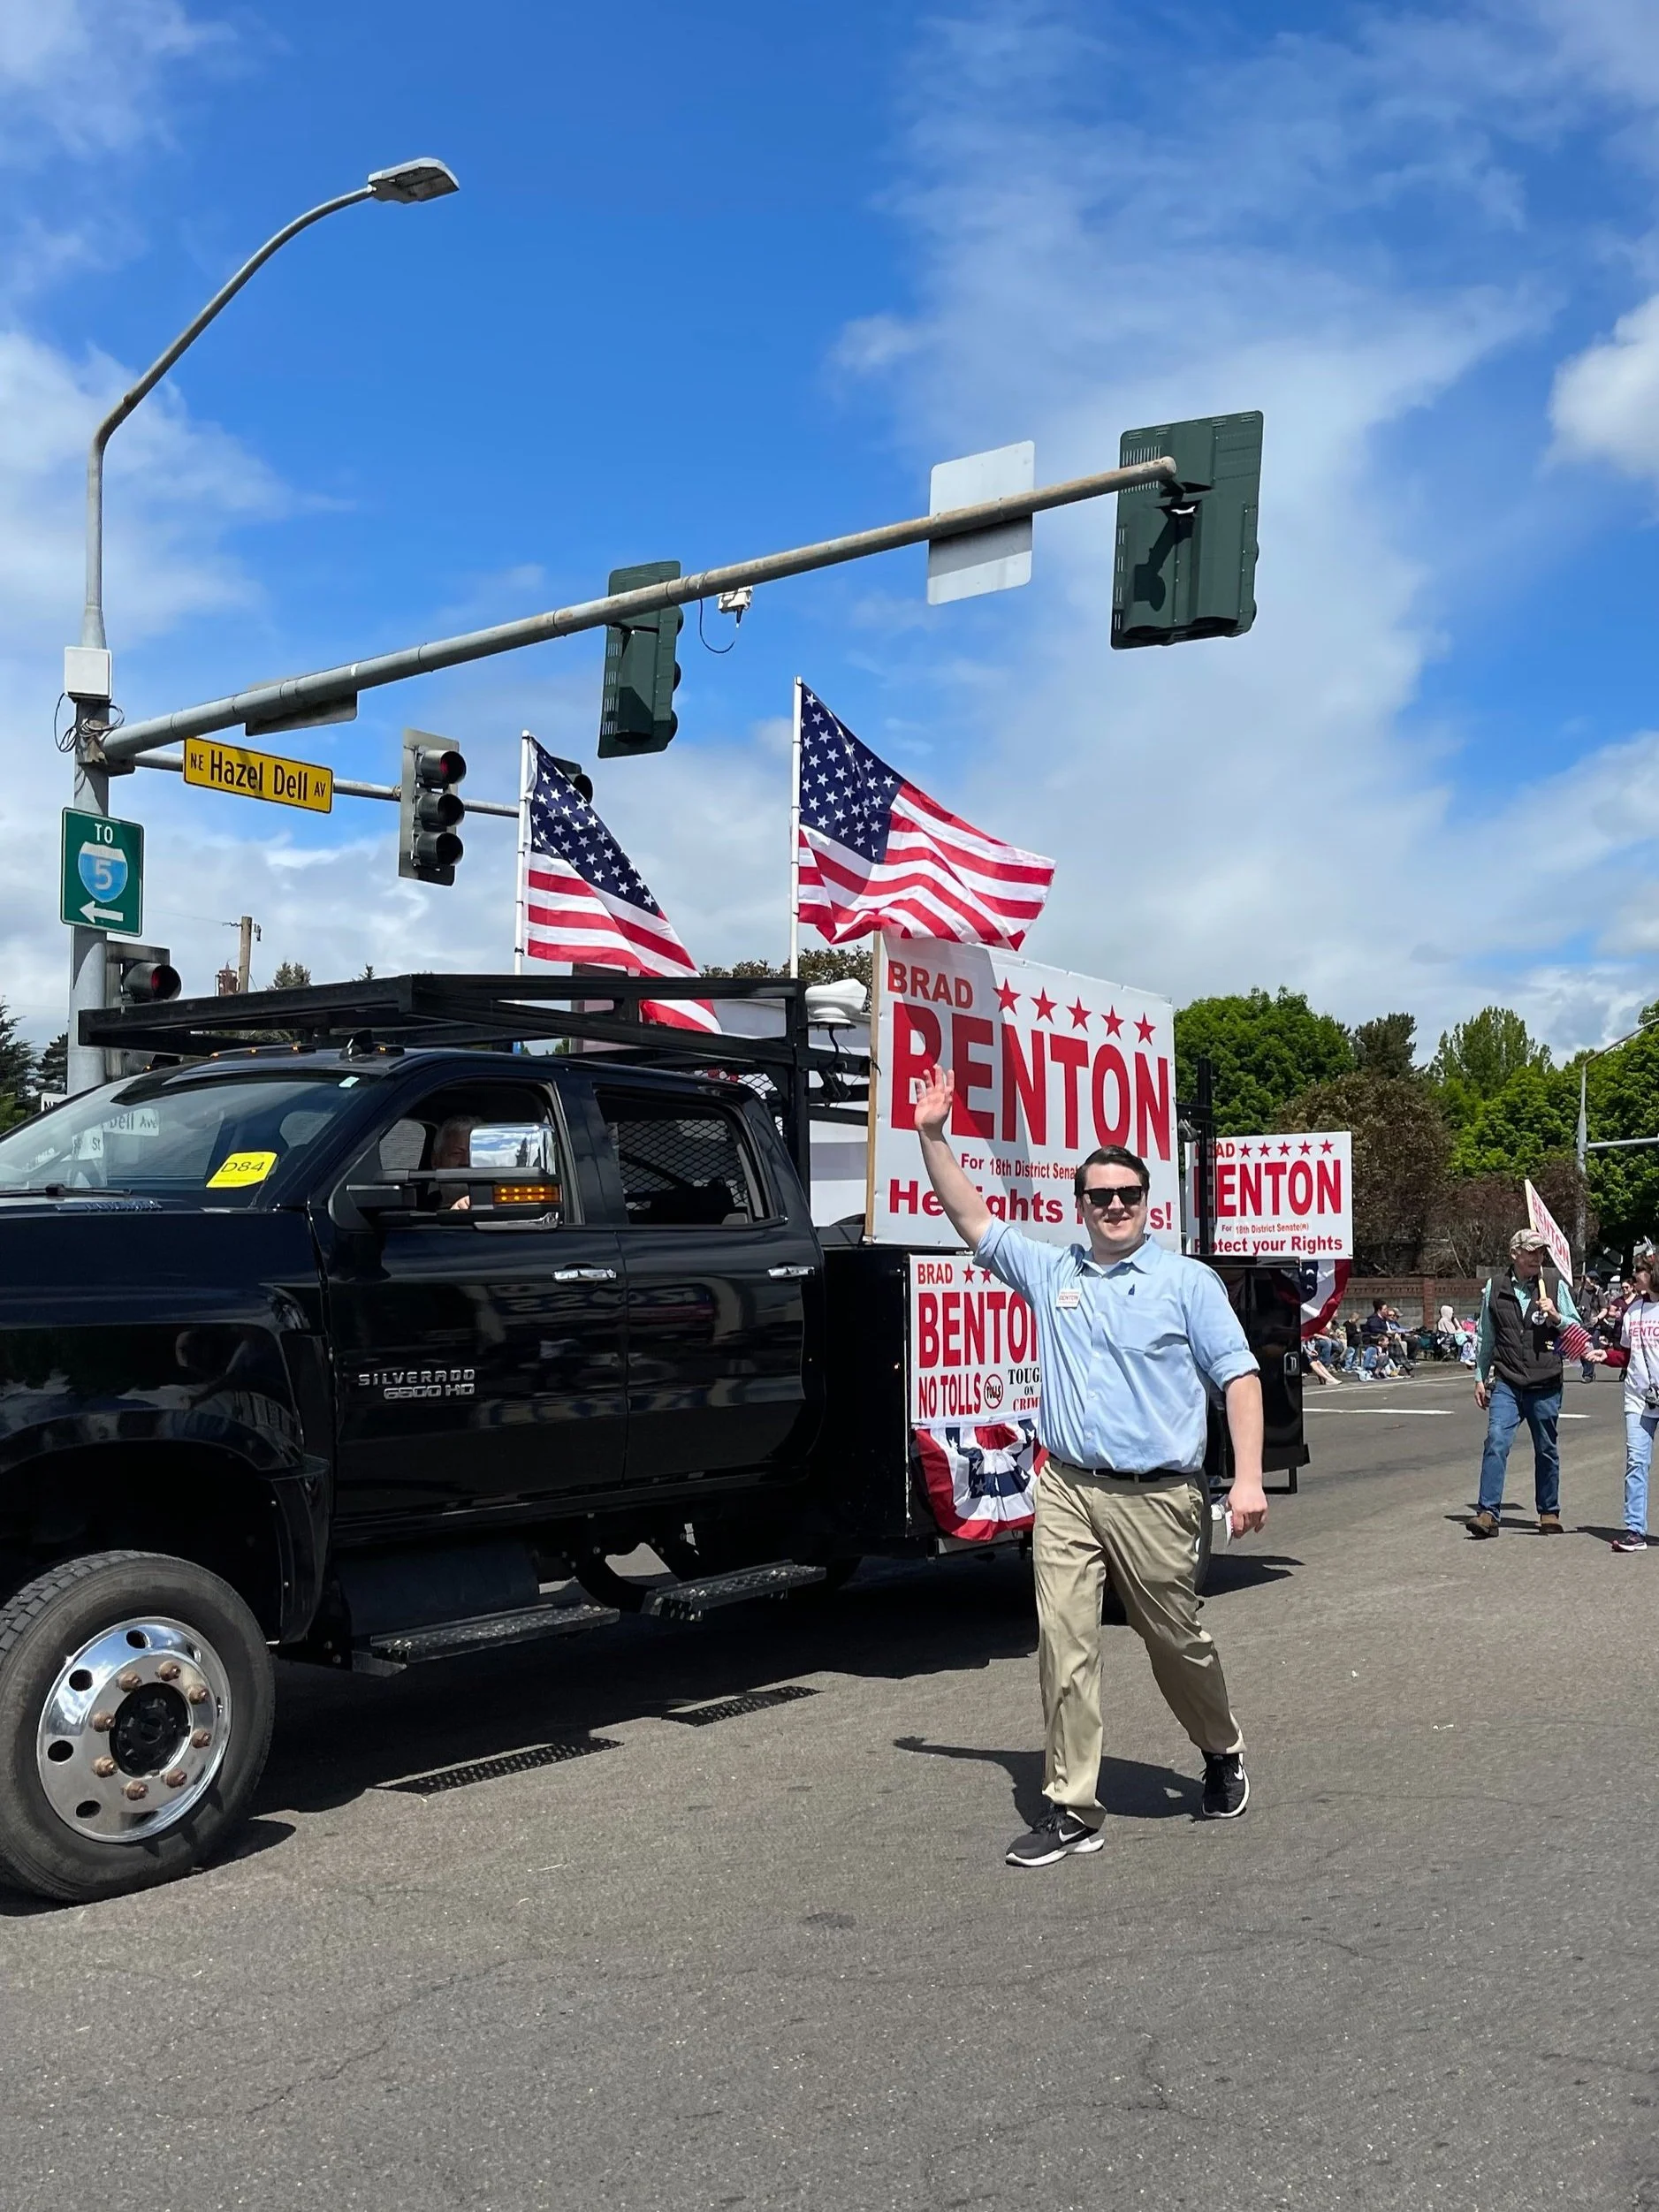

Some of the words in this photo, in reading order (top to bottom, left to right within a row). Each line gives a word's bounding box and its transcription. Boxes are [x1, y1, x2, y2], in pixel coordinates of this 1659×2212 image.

[190, 753, 204, 771] NE
[210, 749, 263, 791] Hazel
[273, 764, 308, 801] Dell
[314, 781, 326, 798] AV
[95, 823, 113, 844] TO
[95, 859, 112, 890] 5
[887, 961, 973, 1008] BRAD
[891, 1001, 1171, 1161] BENTON
[92, 1137, 101, 1152] St
[221, 1161, 265, 1172] D84
[961, 1152, 985, 1170] For
[990, 1158, 1012, 1176] 18th
[1015, 1159, 1050, 1179] District
[1053, 1162, 1078, 1180] Sena
[890, 1179, 945, 1216] He
[1237, 1225, 1249, 1235] 18th
[1251, 1223, 1275, 1234] District
[1252, 1238, 1286, 1256] your
[1291, 1235, 1343, 1255] Rights
[917, 1263, 953, 1285] BRAD
[358, 1369, 475, 1386] SILVERADO
[1008, 1367, 1042, 1385] TOUG
[384, 1385, 441, 1400] 6500
[445, 1384, 475, 1395] HD
[919, 1375, 937, 1419] NO
[940, 1372, 981, 1417] TOLLS
[1024, 1386, 1034, 1395] ON
[1013, 1397, 1040, 1411] CRIM
